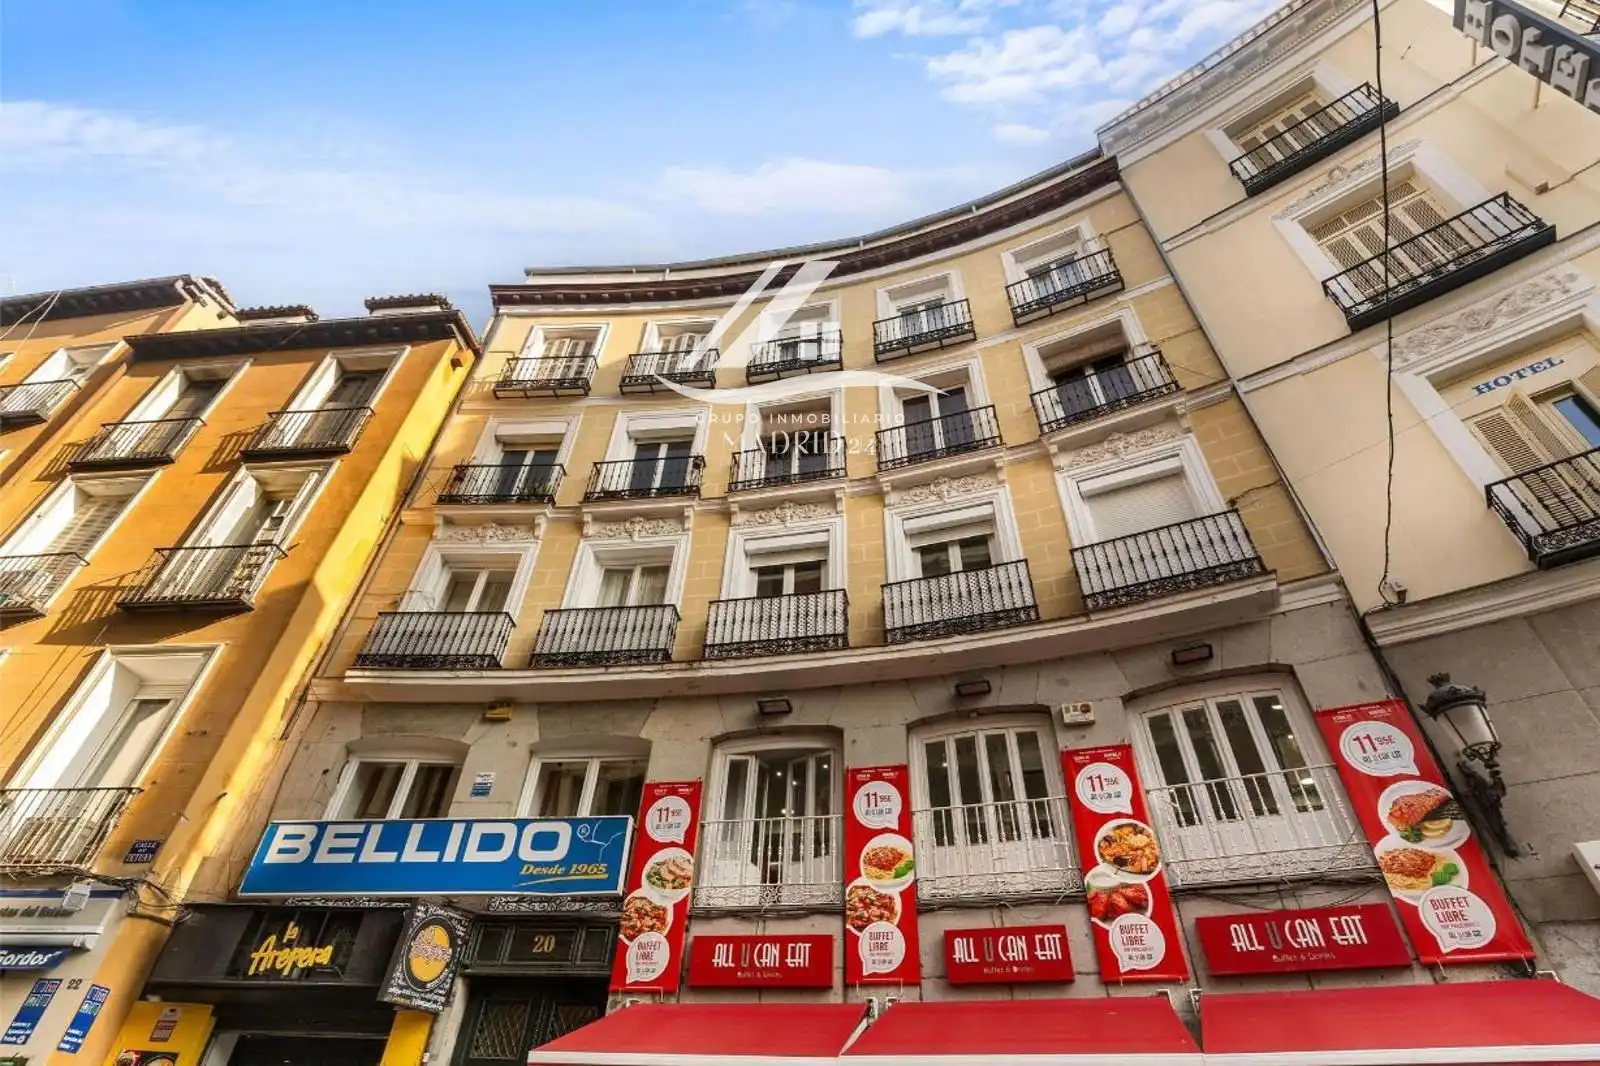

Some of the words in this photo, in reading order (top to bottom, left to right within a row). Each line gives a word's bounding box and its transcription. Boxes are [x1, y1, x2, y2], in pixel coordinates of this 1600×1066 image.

[1472, 357, 1564, 396] HOTEL
[263, 822, 572, 864] BELLIDO
[520, 864, 566, 875] Desde
[569, 863, 608, 875] 1965
[1430, 897, 1470, 911] BUFFET
[1435, 910, 1469, 923] LIBRE
[869, 931, 894, 941] BUFFET
[1119, 923, 1149, 935] BUFFET
[1229, 923, 1265, 952] ALL
[1265, 921, 1283, 950] U
[1284, 918, 1327, 948] CAN
[1328, 915, 1368, 945] EAT
[532, 935, 556, 953] 20
[952, 937, 980, 963] ALL
[983, 937, 994, 962] U
[998, 935, 1028, 961] CAN
[1034, 934, 1063, 960] EAT
[1121, 935, 1146, 946] LIBRE
[248, 934, 333, 976] Arepera
[712, 943, 736, 968] ALL
[741, 943, 751, 968] U
[753, 943, 780, 968] CAN
[785, 942, 812, 968] EAT
[66, 978, 83, 990] 22
